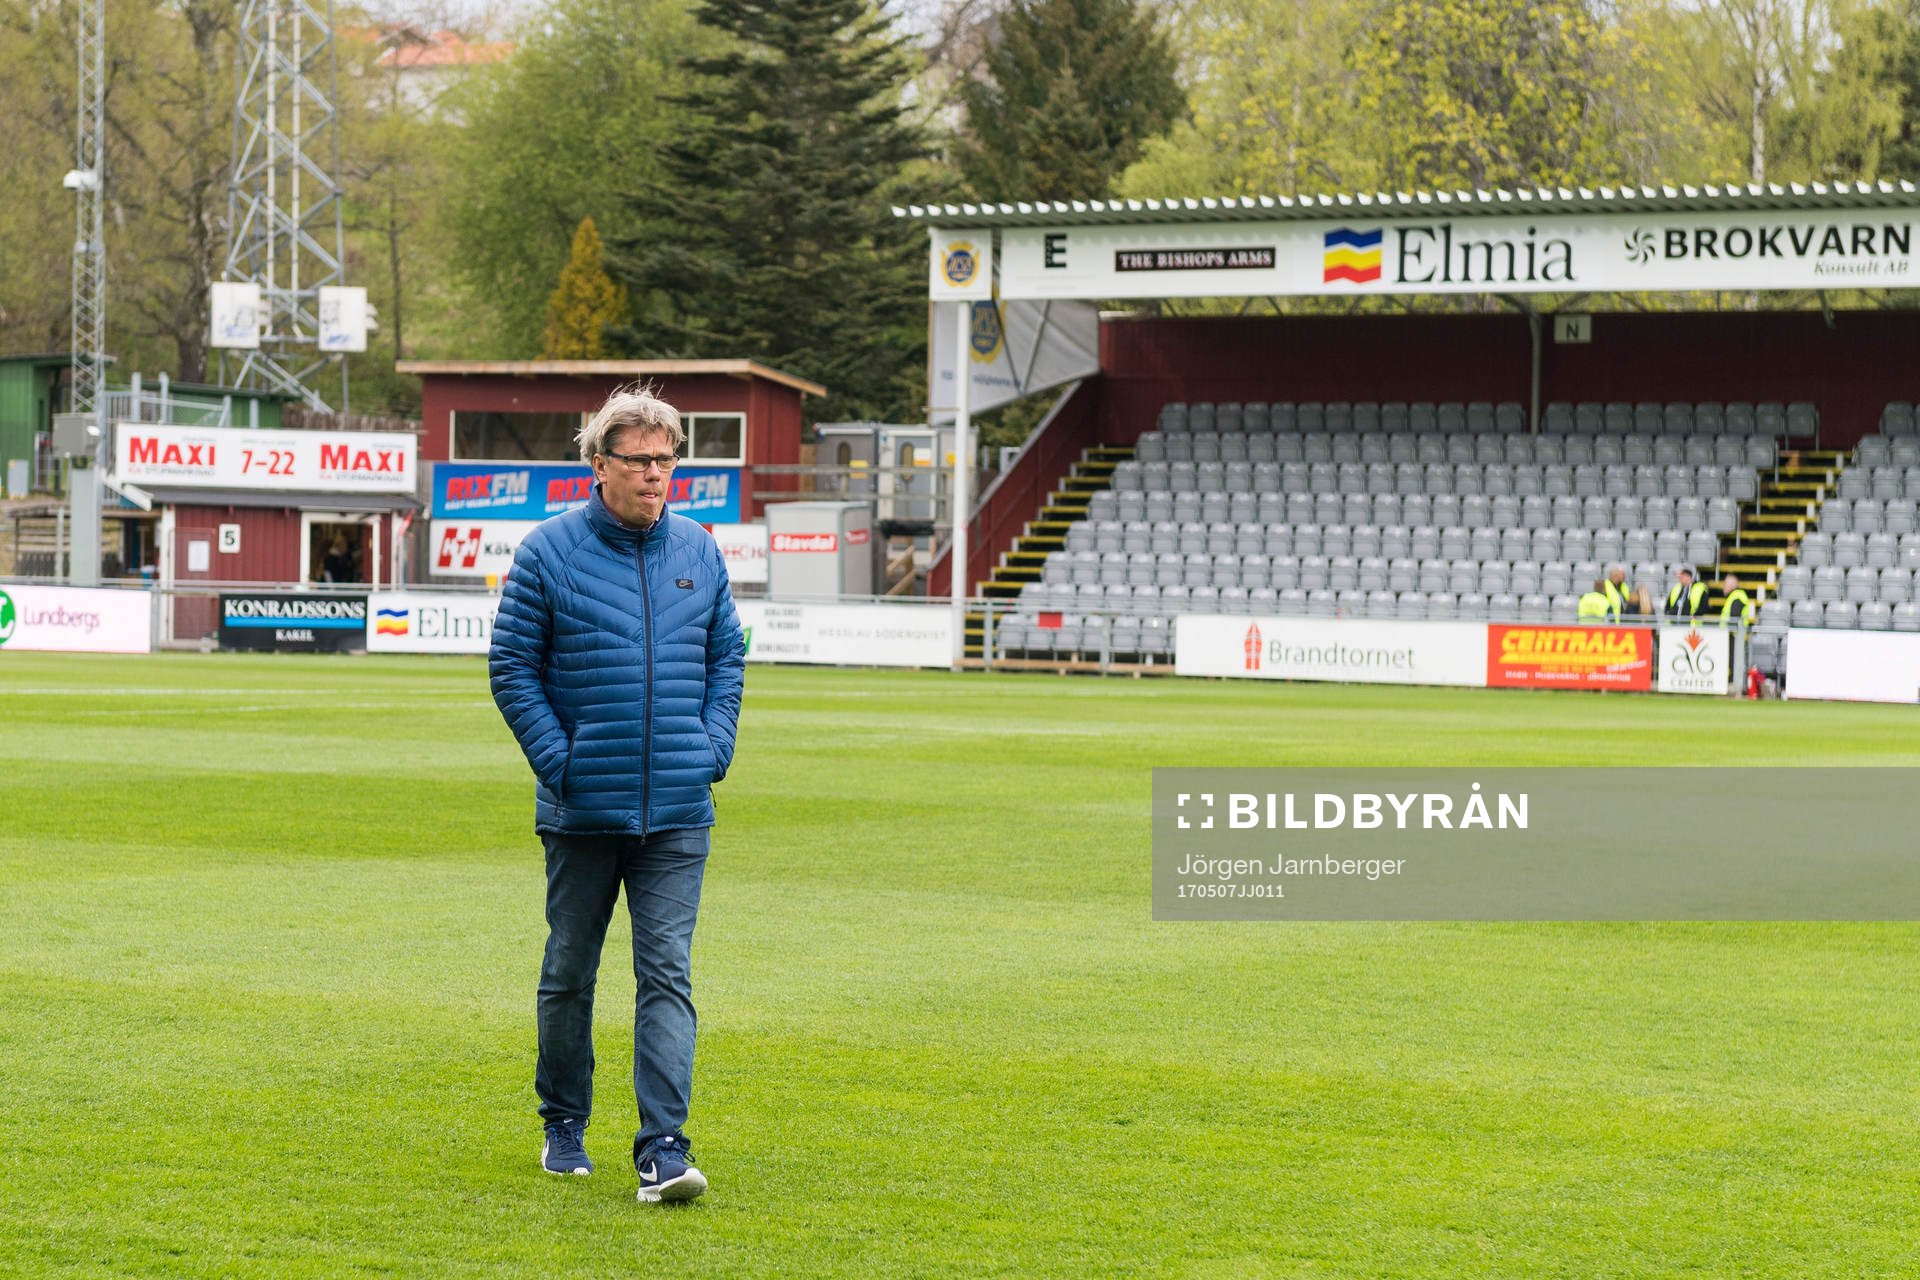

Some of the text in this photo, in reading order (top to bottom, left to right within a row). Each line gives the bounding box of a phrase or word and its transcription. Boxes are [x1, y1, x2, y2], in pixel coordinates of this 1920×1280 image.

[1045, 234, 1067, 268] E
[1394, 222, 1576, 283] Elmia
[1664, 224, 1911, 259] BROKVARN
[1120, 250, 1271, 268] THE BISHOPS ARMS
[1814, 260, 1880, 275] Konsult
[1566, 322, 1580, 340] N
[129, 437, 215, 466] MAXI
[321, 443, 404, 472] MAXI
[547, 477, 594, 503] RIX
[667, 473, 730, 502] IXFM
[224, 530, 236, 546] 5
[484, 541, 515, 556] Kök
[773, 535, 835, 551] Stavdal
[24, 605, 100, 634] Lundbergs
[224, 599, 366, 619] KONRADSSONS
[416, 608, 494, 638] Elmi
[1269, 639, 1416, 669] Brandtornet
[1501, 629, 1637, 655] CENTRALA
